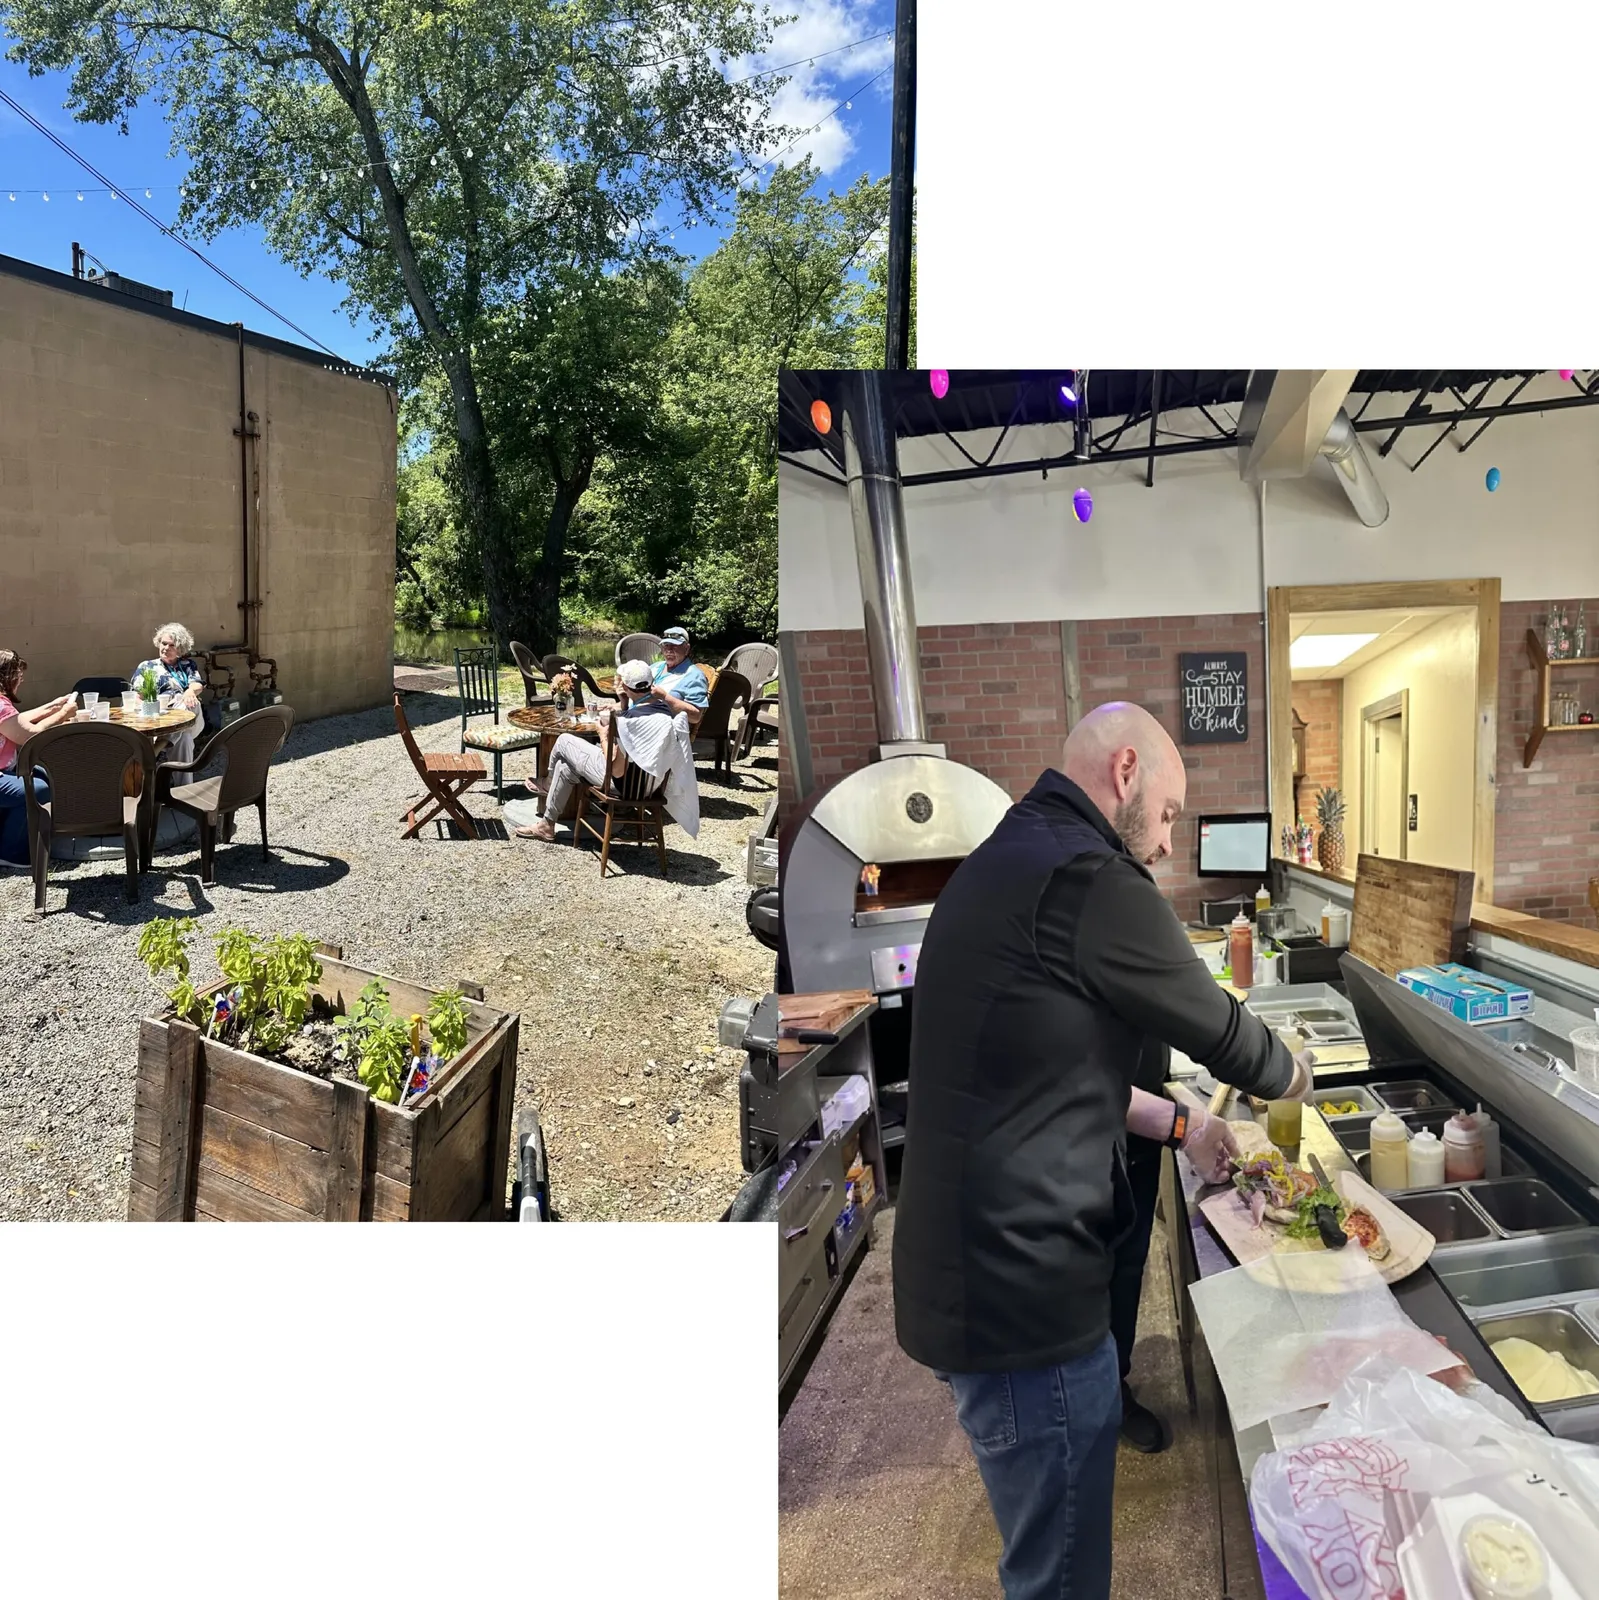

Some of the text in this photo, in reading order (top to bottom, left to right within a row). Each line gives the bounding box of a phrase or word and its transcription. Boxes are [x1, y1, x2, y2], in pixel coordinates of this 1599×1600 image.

[1203, 661, 1228, 670] ALWAYS
[1210, 671, 1242, 685] STAY
[1185, 685, 1245, 708] HUMBLE
[1206, 706, 1245, 734] kind
